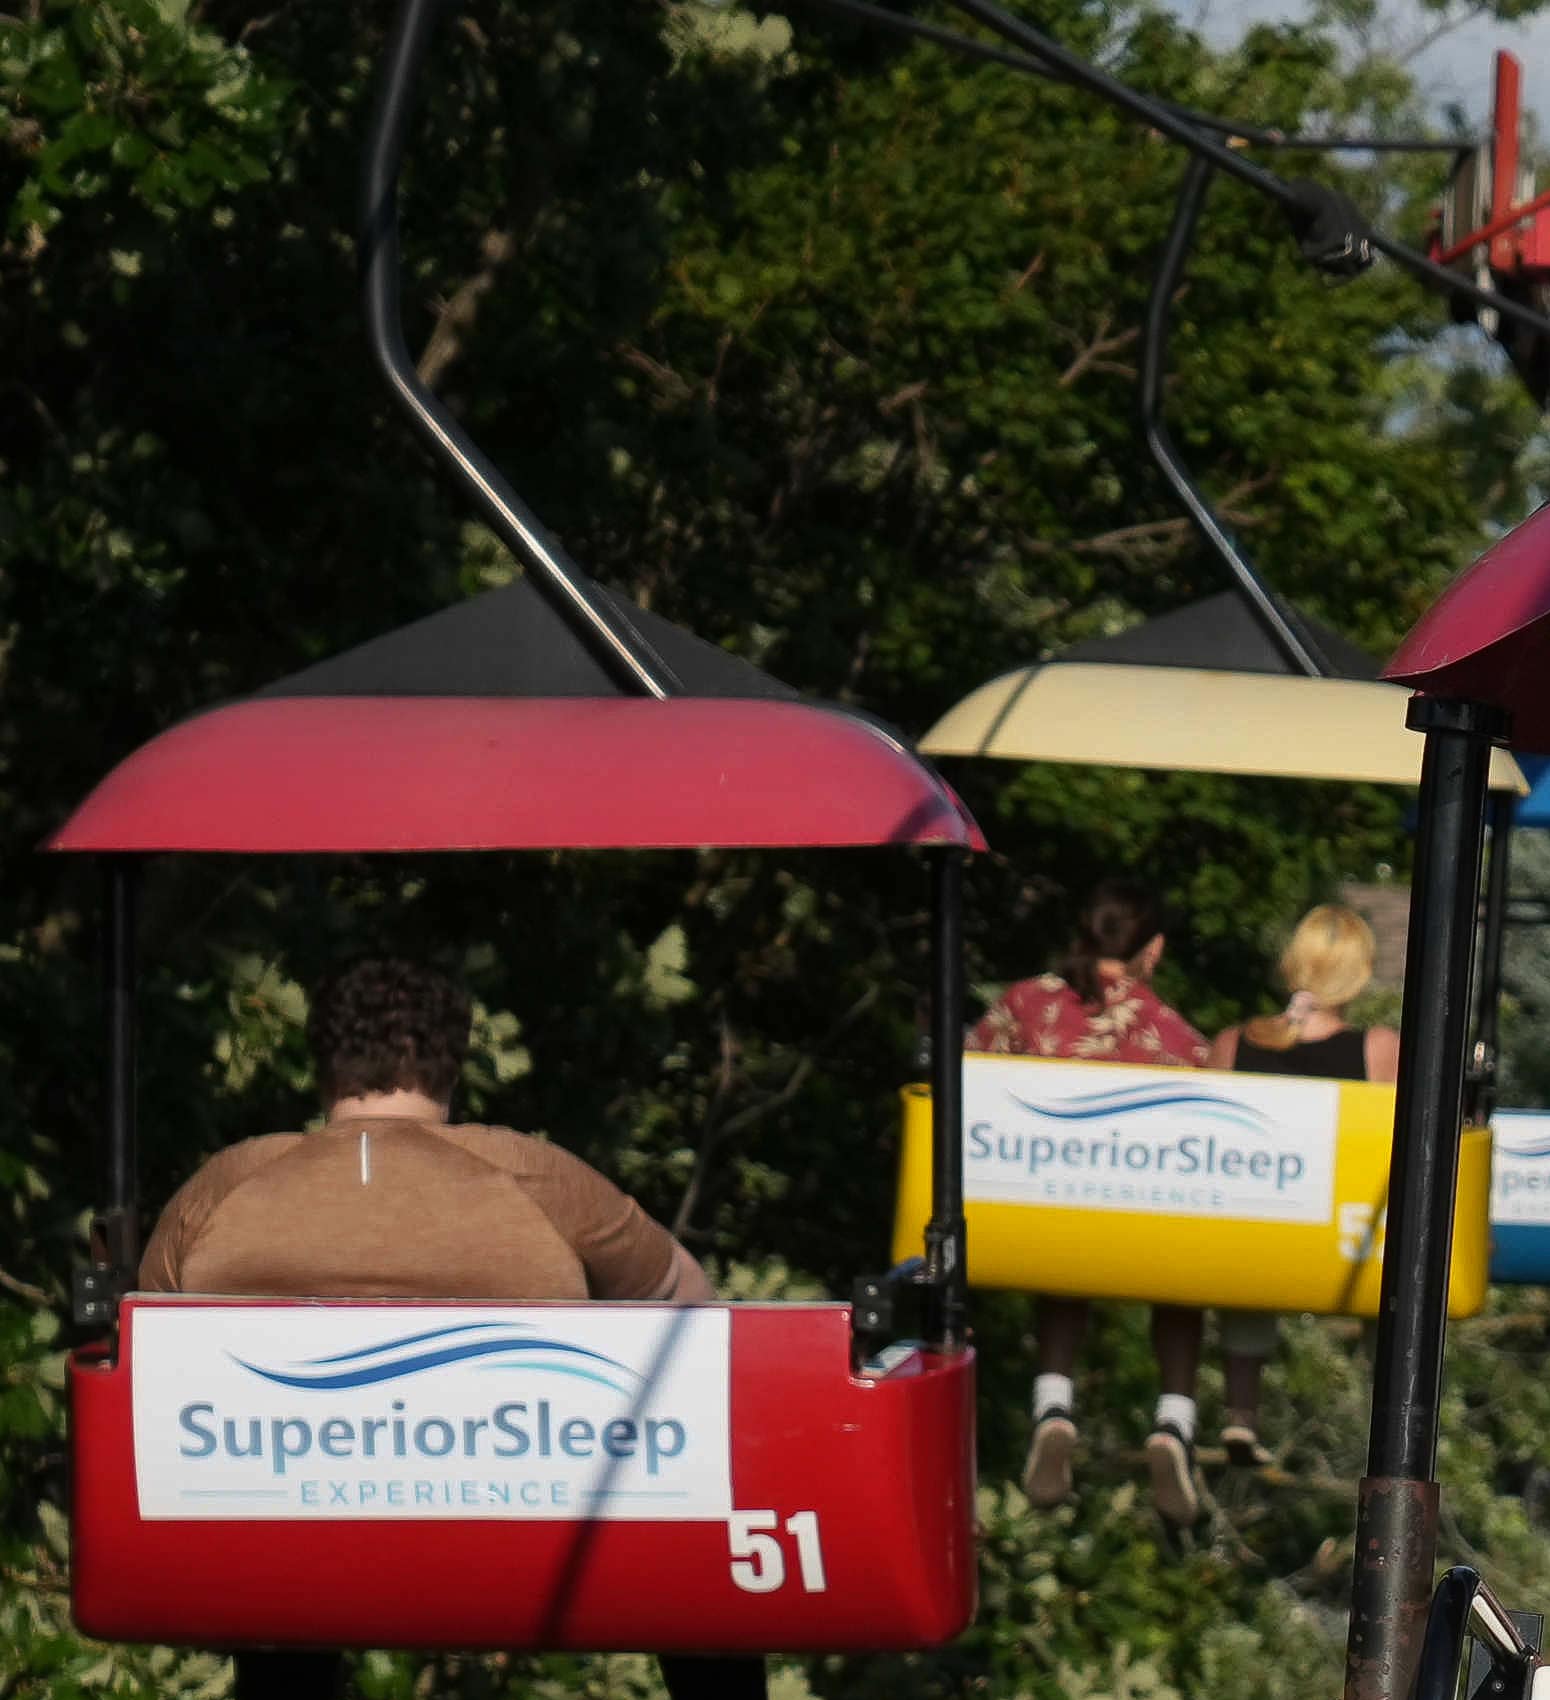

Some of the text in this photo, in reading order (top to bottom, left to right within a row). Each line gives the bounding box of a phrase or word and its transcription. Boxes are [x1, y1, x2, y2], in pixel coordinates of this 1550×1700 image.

[968, 1122, 1305, 1190] SuperiorSleep
[1339, 1203, 1386, 1262] 5
[178, 1401, 686, 1473] SuperiorSleep
[300, 1480, 569, 1505] EXPERIENCE
[729, 1509, 826, 1593] 51
